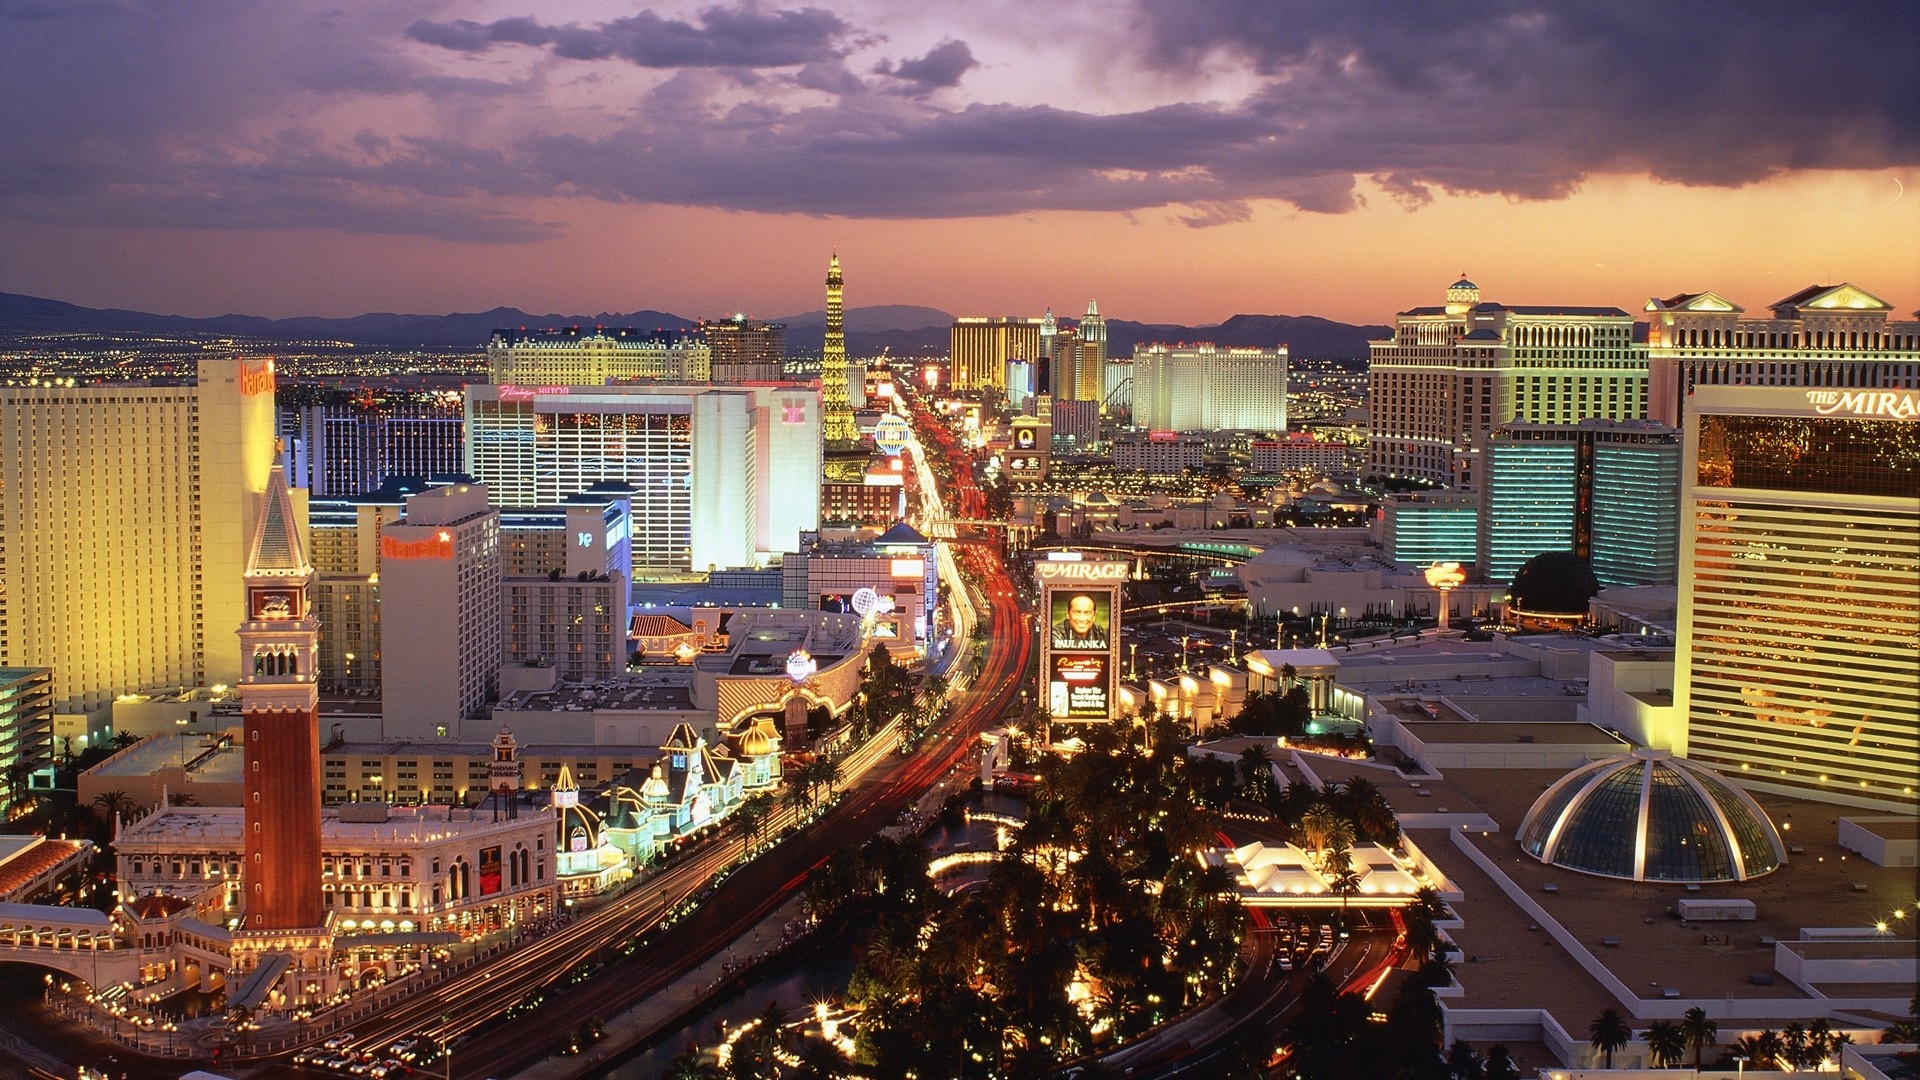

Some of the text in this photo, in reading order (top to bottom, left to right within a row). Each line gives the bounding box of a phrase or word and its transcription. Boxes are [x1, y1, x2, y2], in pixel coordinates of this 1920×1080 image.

[865, 371, 892, 380] MGM
[1805, 390, 1920, 419] THE MIRA
[1036, 563, 1127, 580] THE MIRAGE
[1054, 639, 1107, 649] PAUL ANKA
